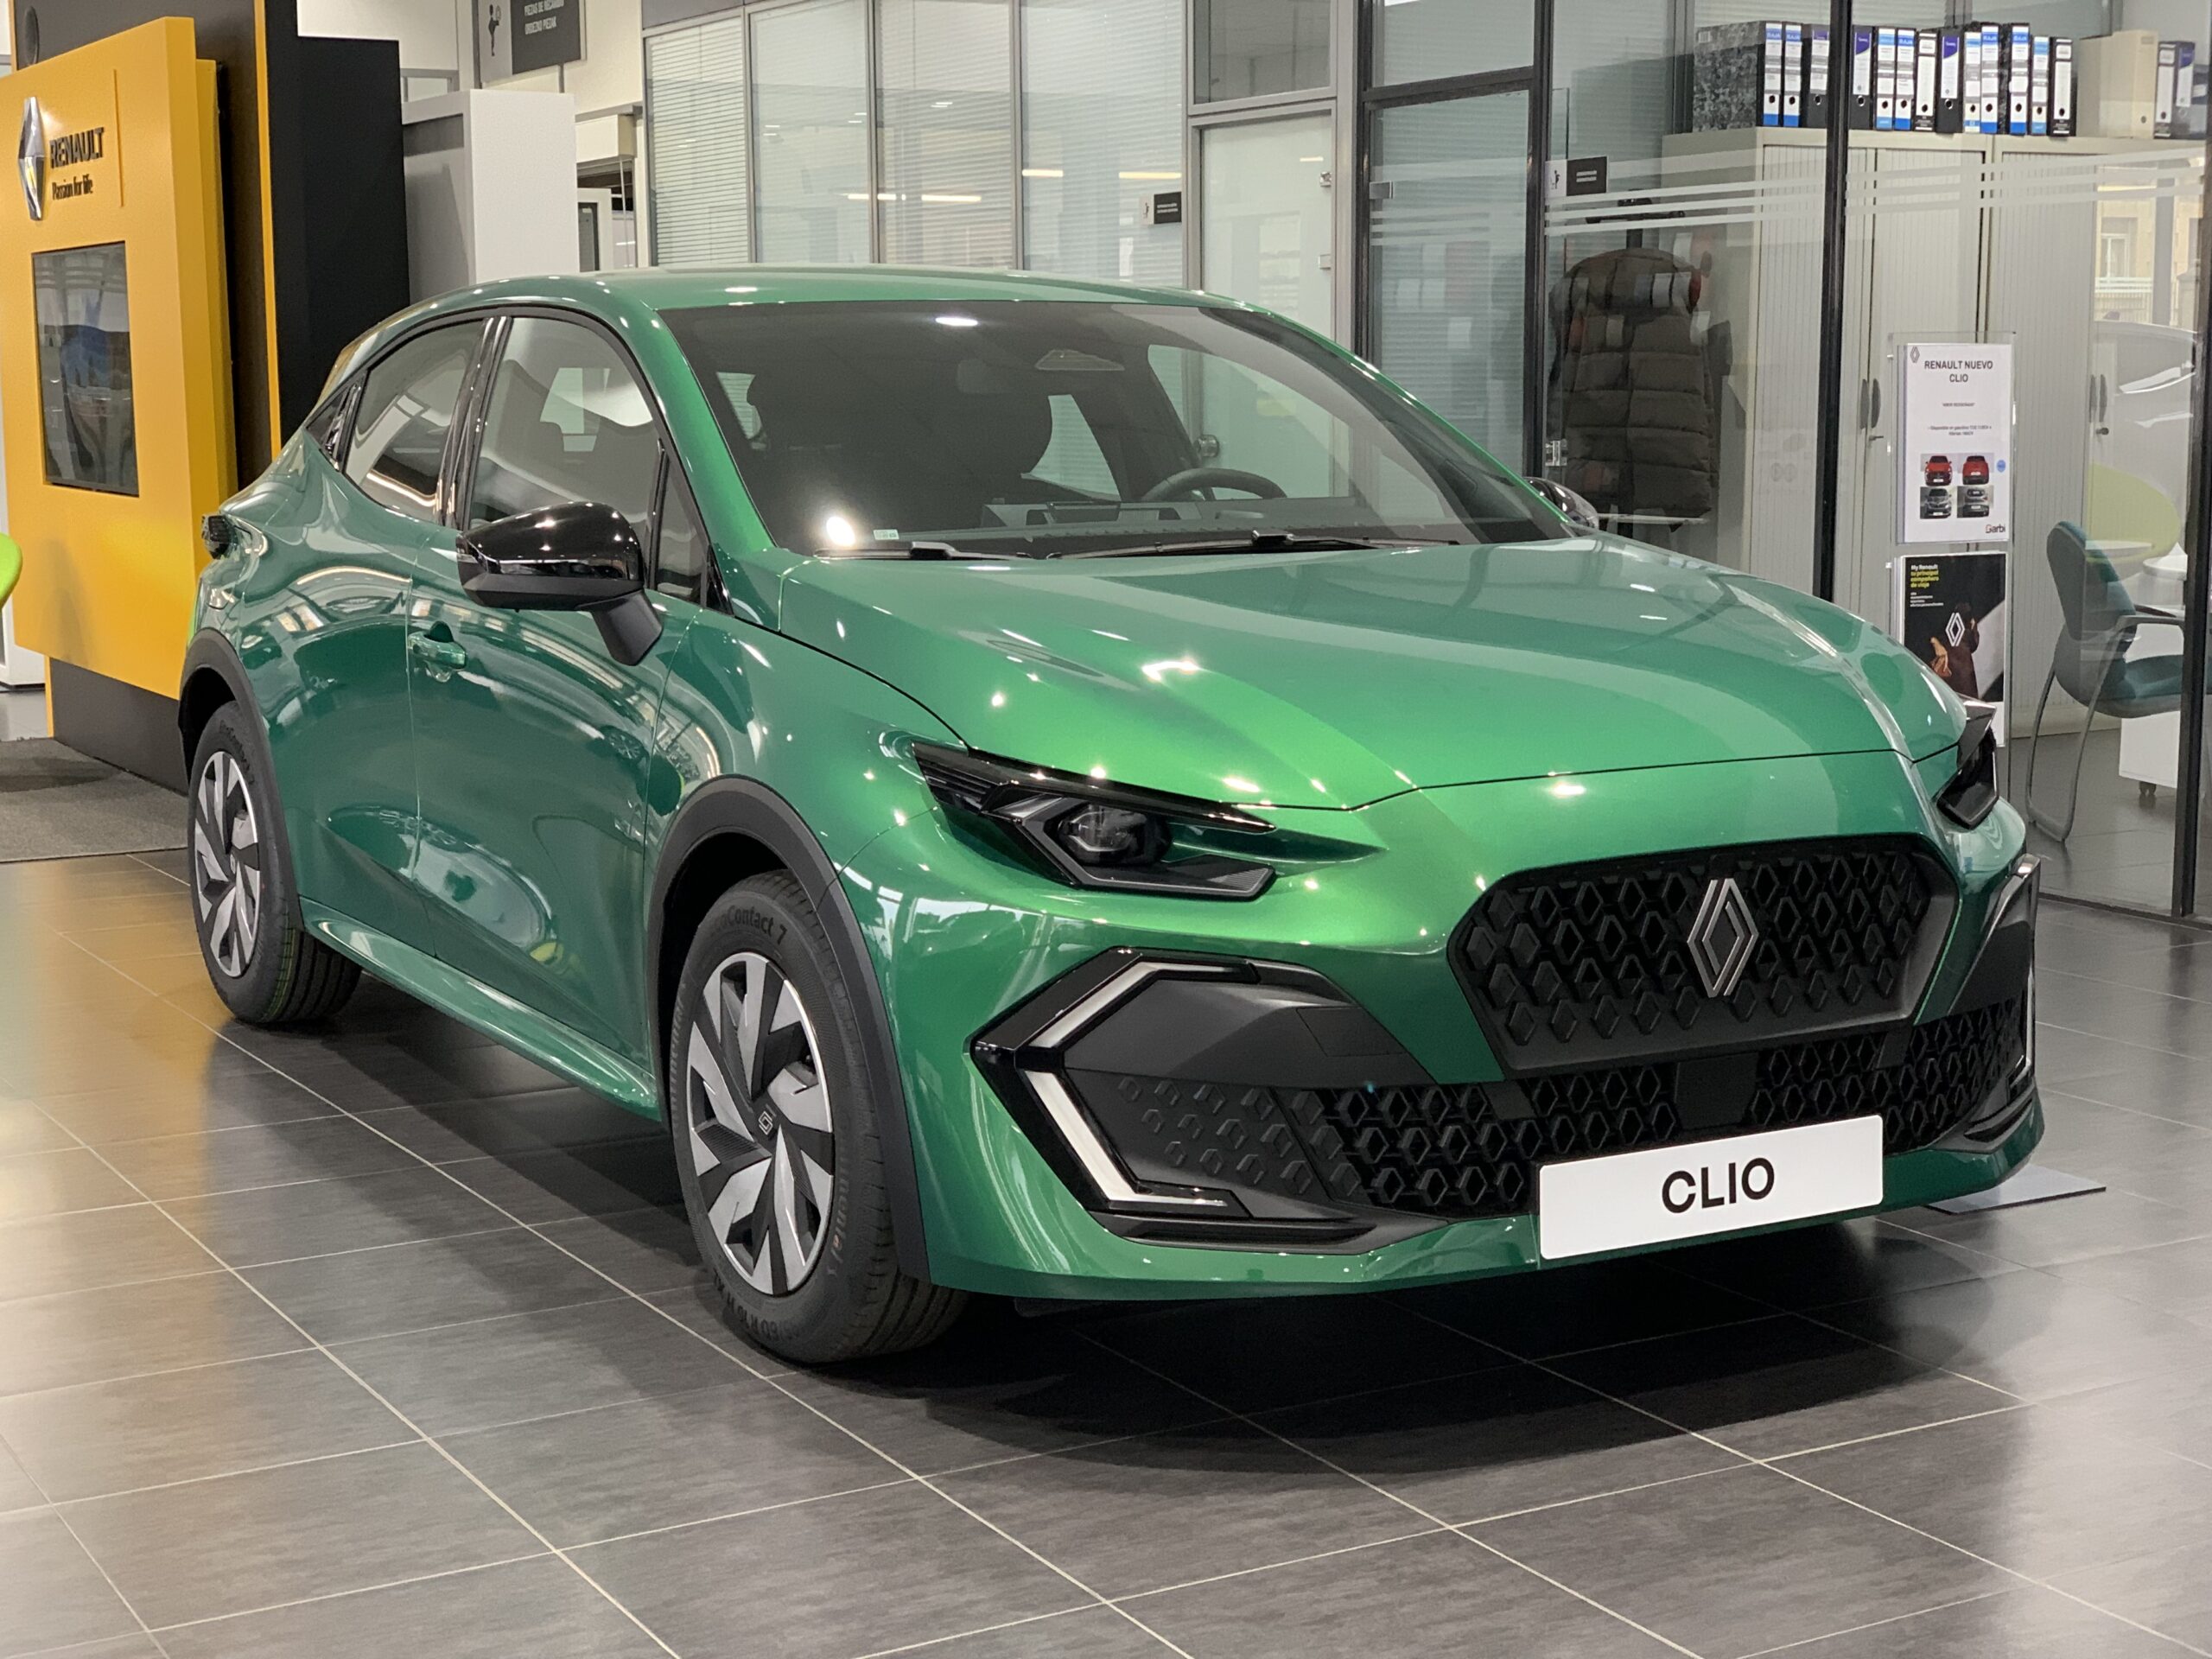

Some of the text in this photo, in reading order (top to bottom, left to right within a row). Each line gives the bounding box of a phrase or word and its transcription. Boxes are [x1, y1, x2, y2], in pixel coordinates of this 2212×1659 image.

[50, 127, 105, 168] RENAULT
[52, 174, 93, 200] Passion for life
[1924, 360, 1993, 370] RENAULT NUEVO
[1949, 373, 1968, 383] CLIO
[777, 924, 788, 945] 7
[1662, 1157, 1775, 1214] CLIO
